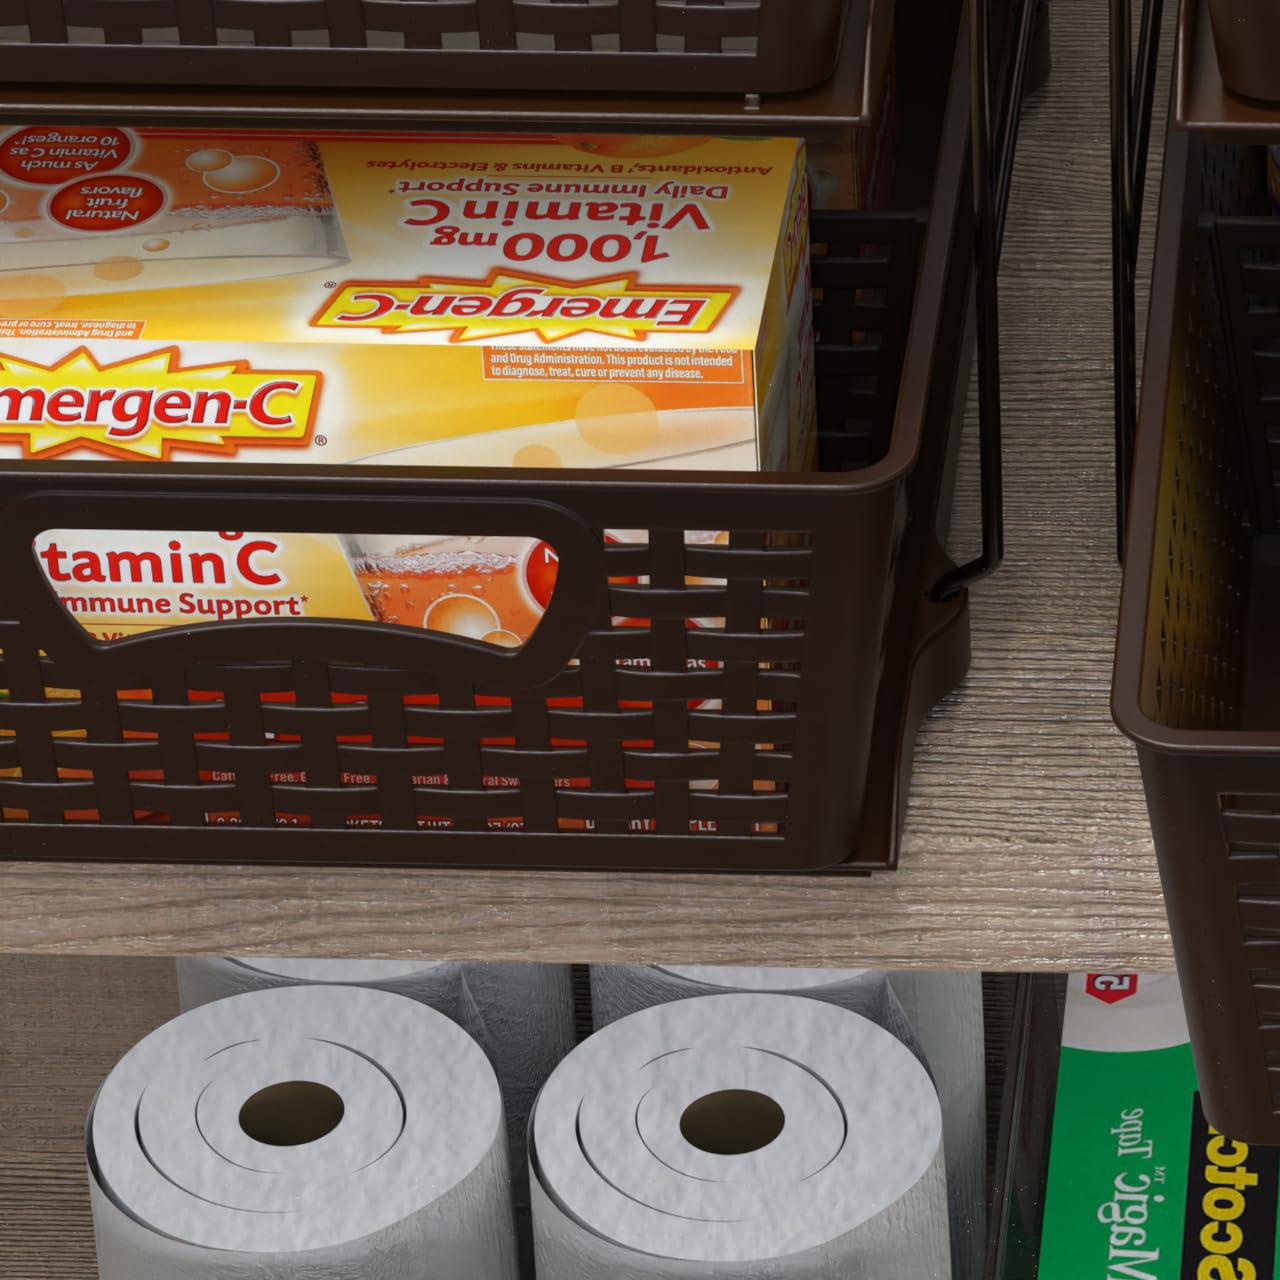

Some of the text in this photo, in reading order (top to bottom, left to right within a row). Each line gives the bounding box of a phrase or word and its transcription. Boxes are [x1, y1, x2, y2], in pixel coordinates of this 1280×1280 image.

[100, 136, 120, 146] 10
[9, 147, 29, 155] as
[49, 147, 118, 159] Vitamin
[21, 160, 99, 171] As much
[366, 159, 490, 173] Electrolytes
[512, 161, 604, 174] Vitamins
[80, 186, 144, 198] flavors
[526, 181, 646, 199] Immune
[658, 181, 728, 200] Daily
[87, 197, 129, 209] fruit
[65, 209, 140, 221] Natural
[404, 198, 710, 230] Vitamin C
[430, 225, 670, 264] 1,000 mg
[340, 287, 706, 327] Emergen-C
[491, 353, 509, 364] and
[510, 353, 532, 366] Drug
[533, 353, 604, 365] Administration.
[606, 353, 626, 366] This
[627, 354, 664, 368] product
[674, 355, 690, 366] not
[691, 355, 733, 367] intended
[490, 366, 501, 376] to
[575, 368, 597, 378] cure
[598, 368, 608, 378] or
[609, 368, 646, 380] prevent
[646, 369, 664, 380] any
[236, 540, 282, 586] C
